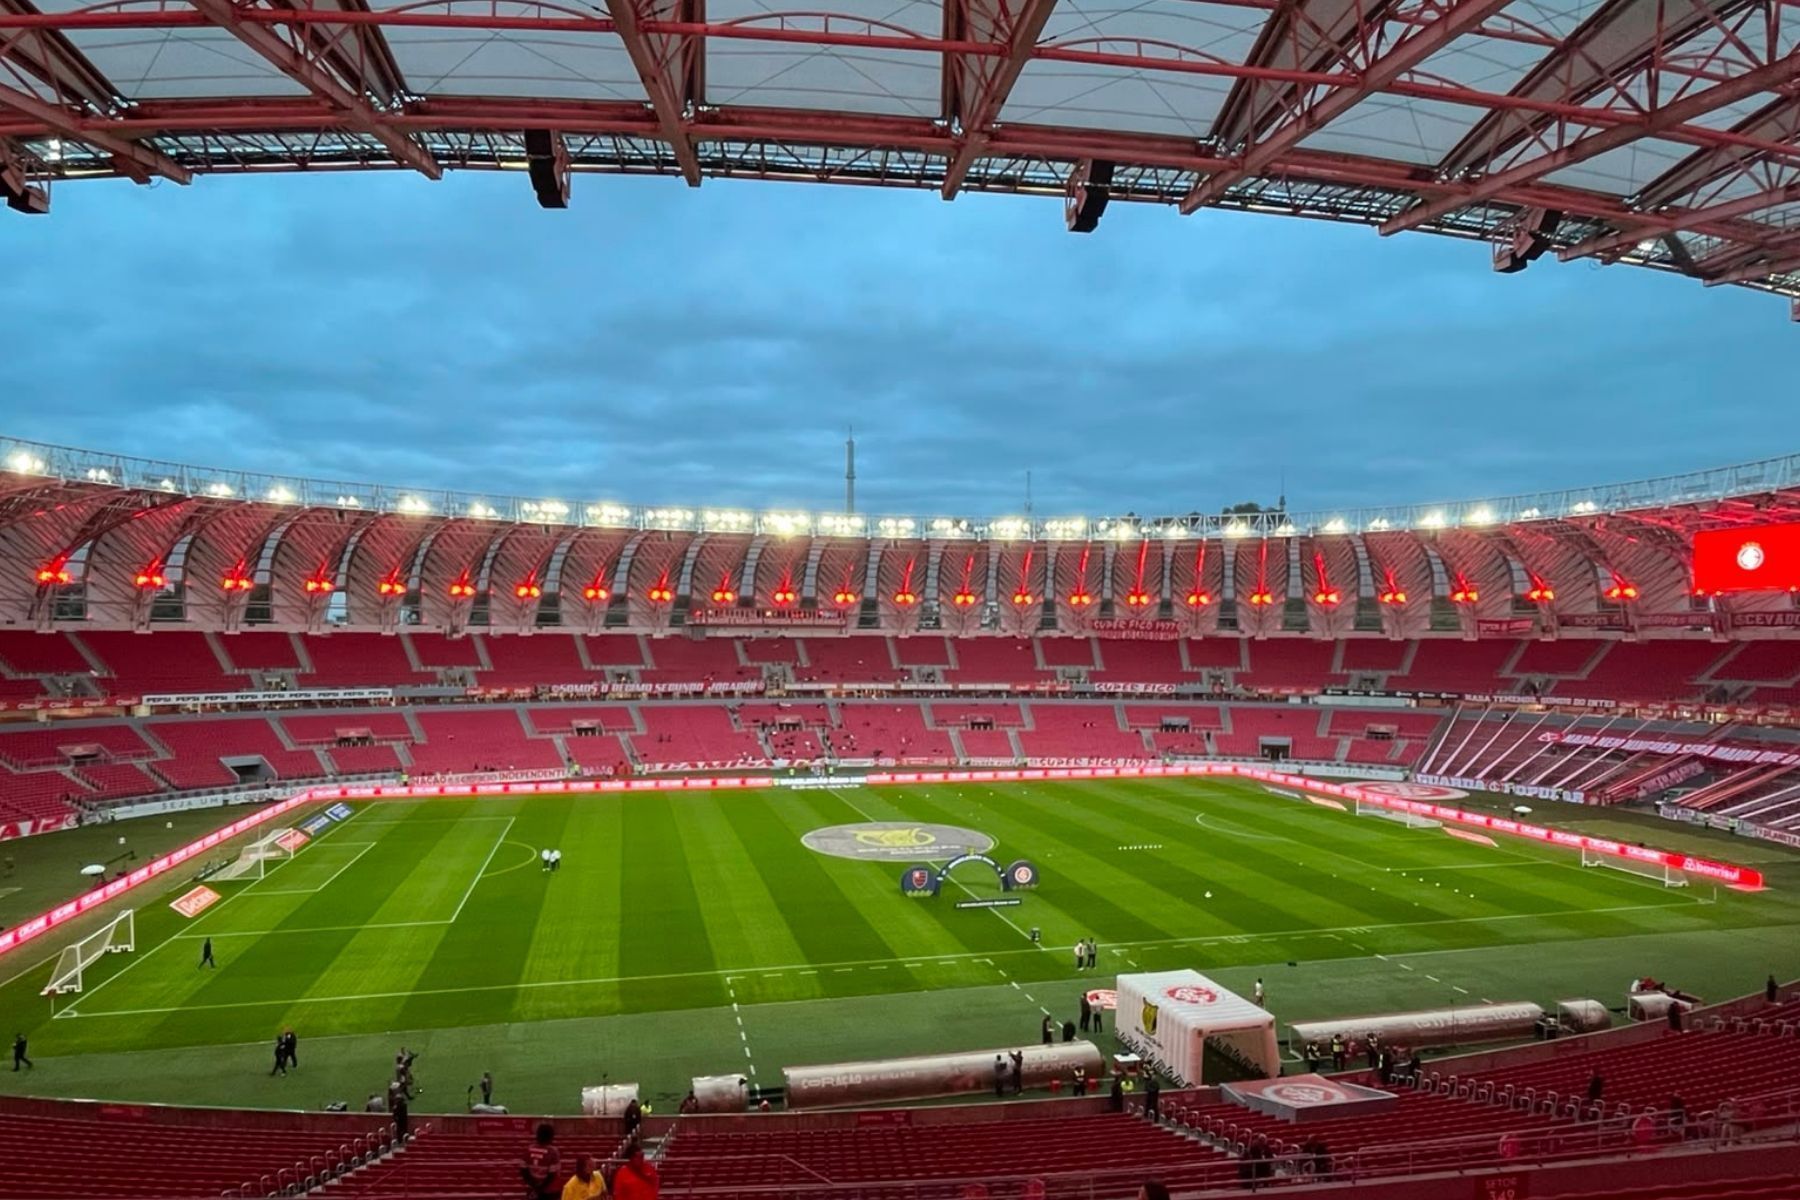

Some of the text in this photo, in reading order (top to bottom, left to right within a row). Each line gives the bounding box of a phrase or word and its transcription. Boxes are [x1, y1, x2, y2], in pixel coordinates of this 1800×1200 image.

[1143, 683, 1174, 693] FICO
[161, 799, 193, 810] SEJA
[200, 796, 219, 806] UM
[1695, 861, 1740, 880] banrisul
